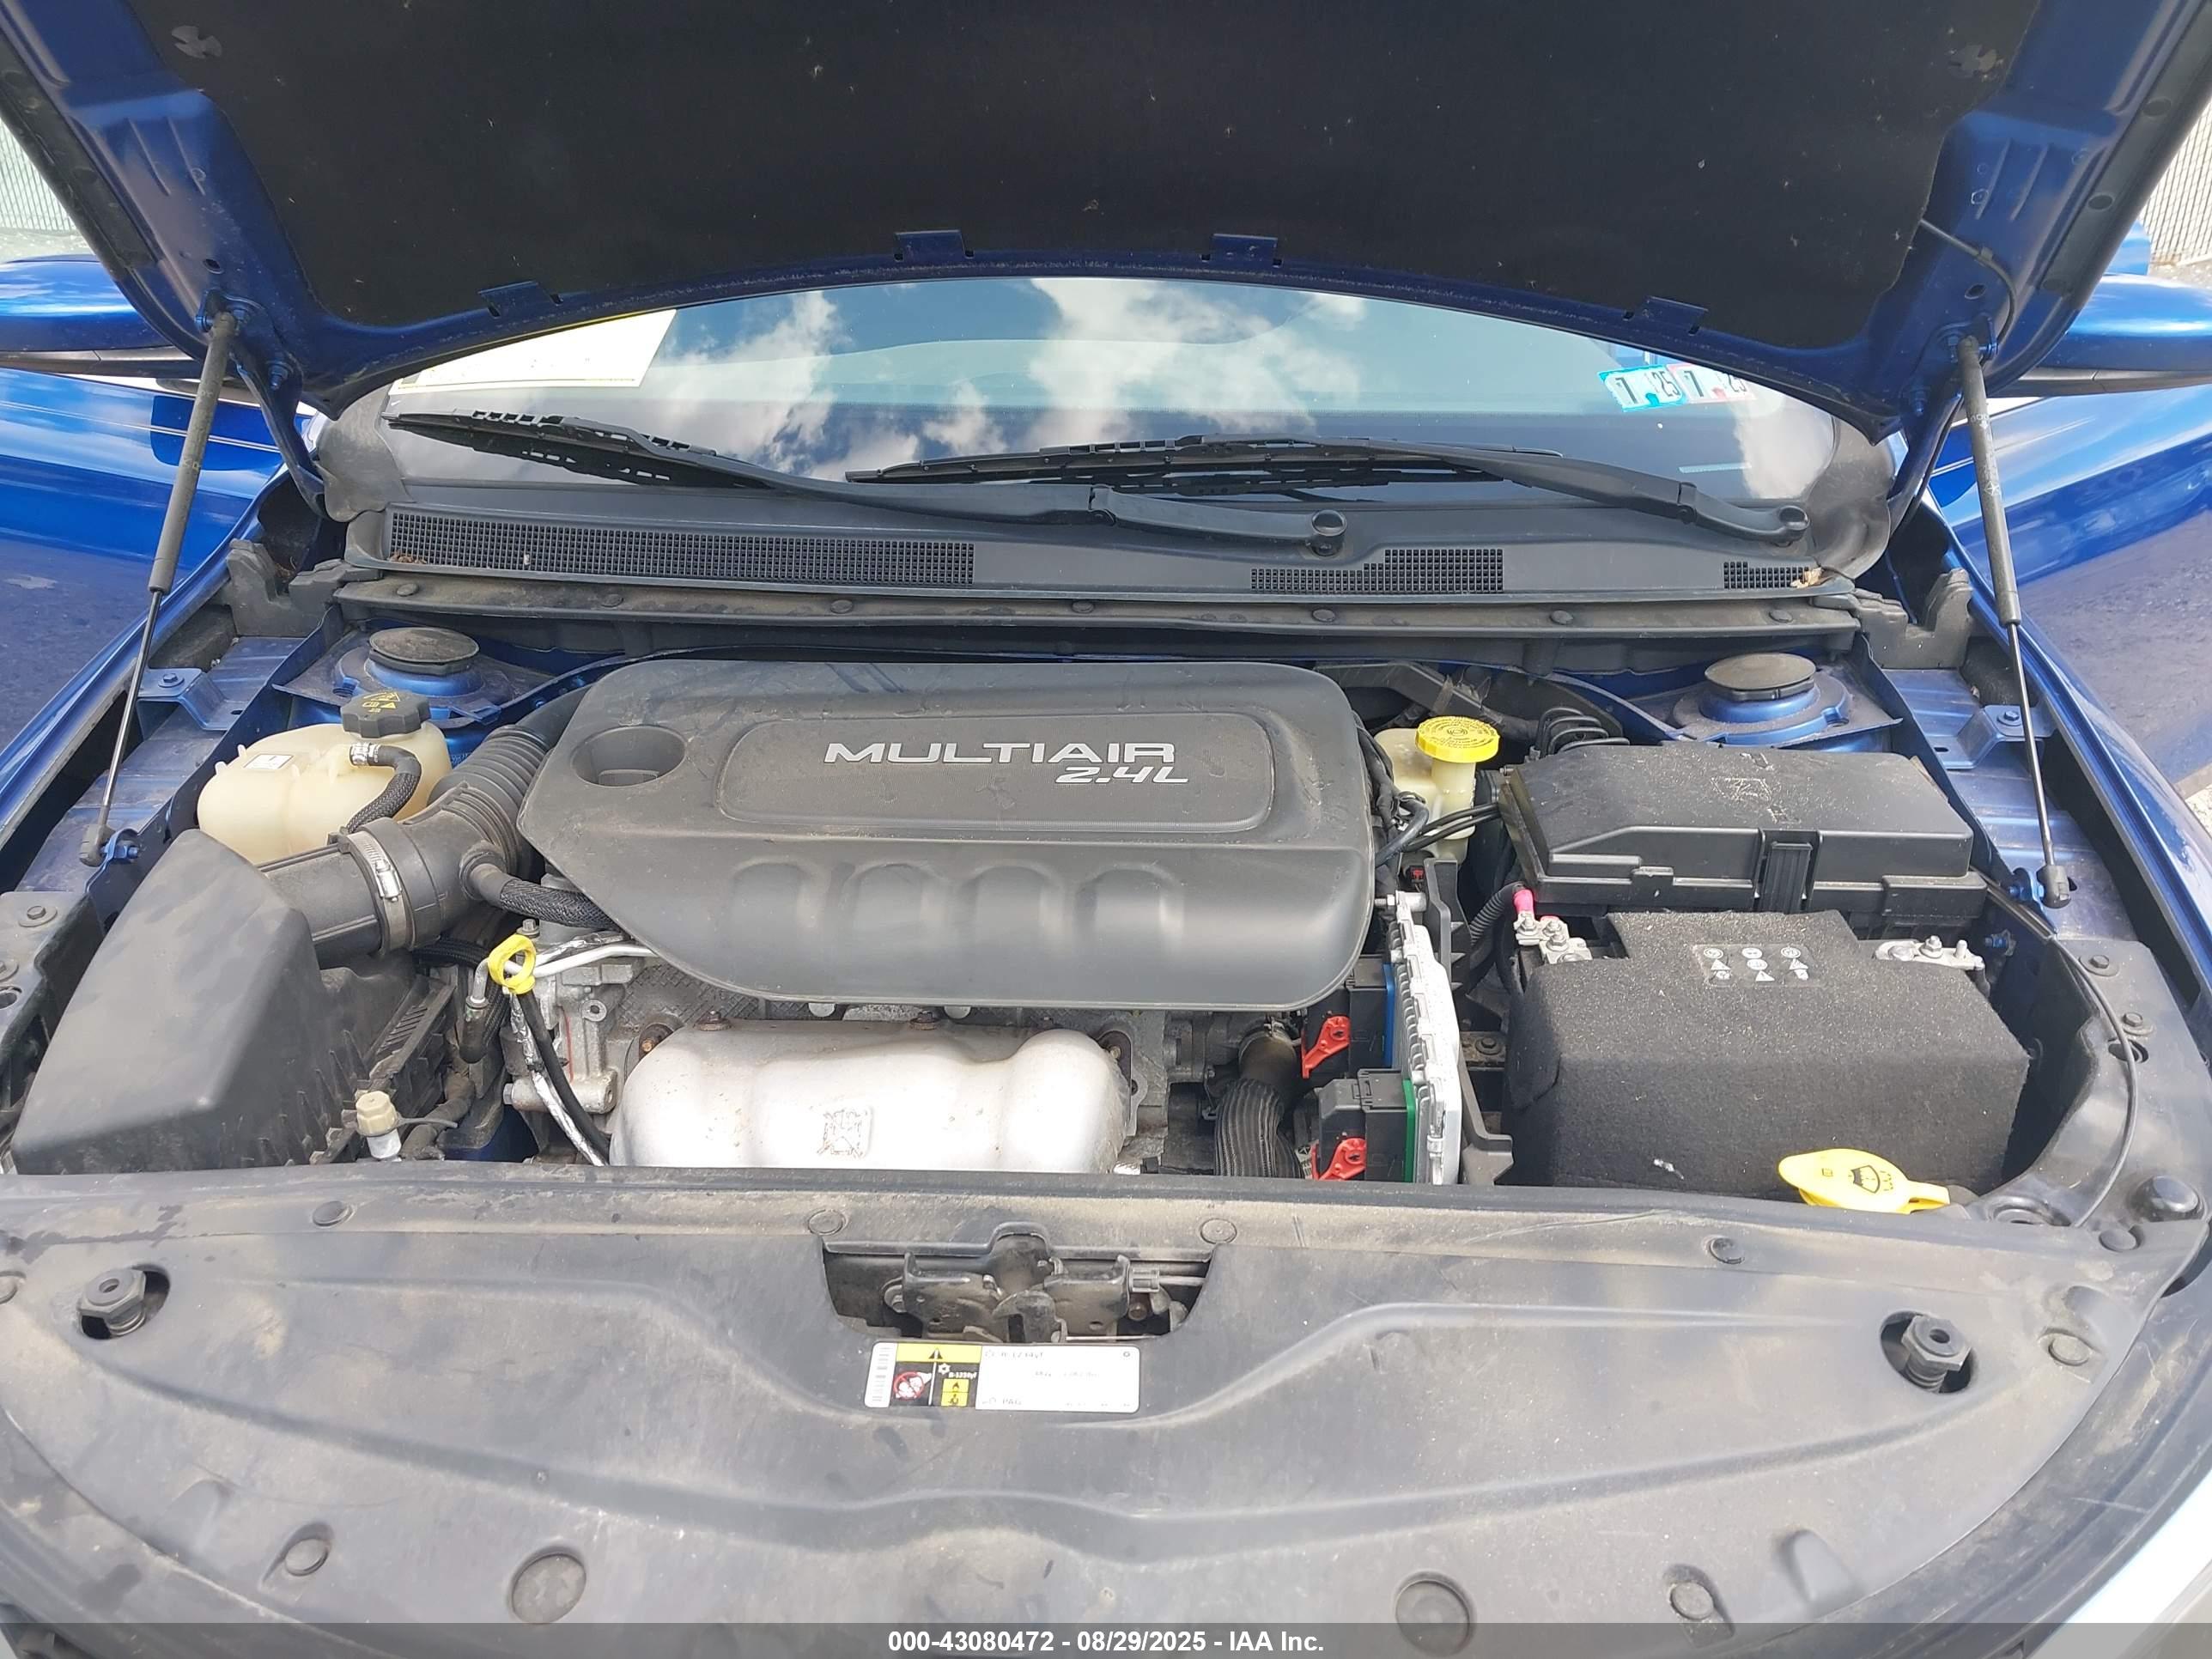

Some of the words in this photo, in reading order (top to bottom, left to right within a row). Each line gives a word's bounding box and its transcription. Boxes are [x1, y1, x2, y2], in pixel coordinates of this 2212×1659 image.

[1651, 370, 1680, 398] 25
[823, 742, 1176, 763] MULTIAIR
[1054, 765, 1189, 785] 2.4L
